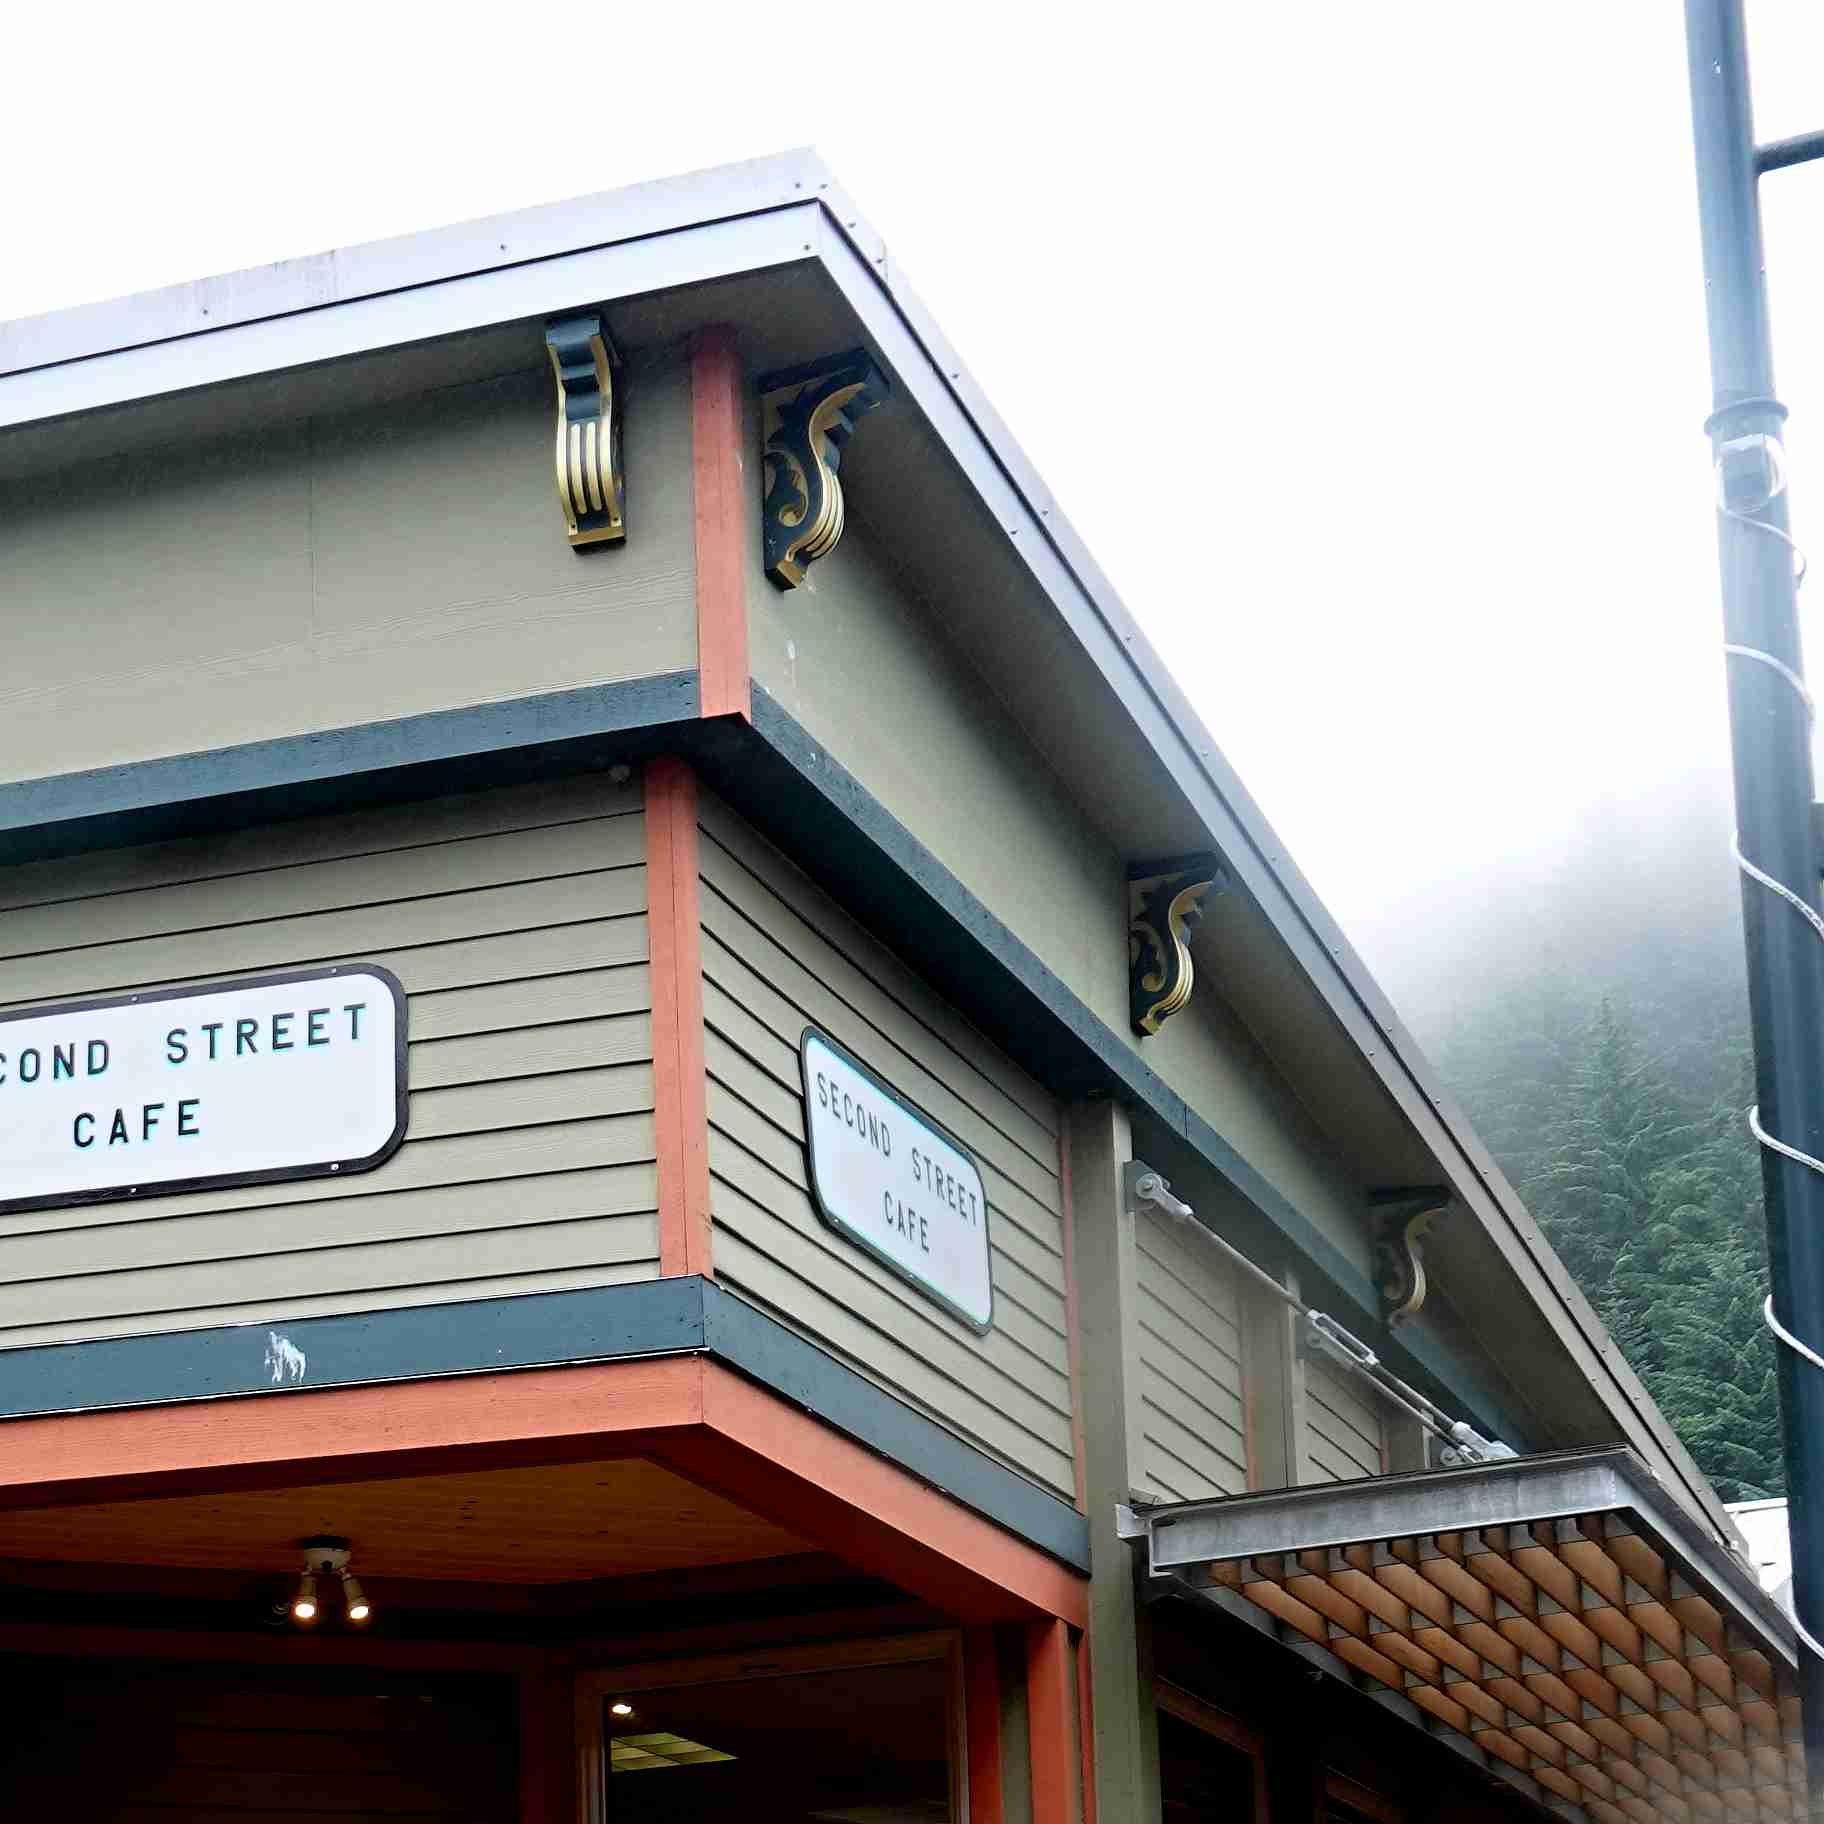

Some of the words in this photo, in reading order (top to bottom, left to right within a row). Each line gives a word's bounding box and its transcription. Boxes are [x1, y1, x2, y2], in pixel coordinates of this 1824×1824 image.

[166, 1003, 368, 1065] STREET
[73, 1098, 202, 1149] CAFE
[816, 1071, 892, 1158] SECOND
[911, 1146, 977, 1227] STREET
[884, 1190, 930, 1253] CAFE
